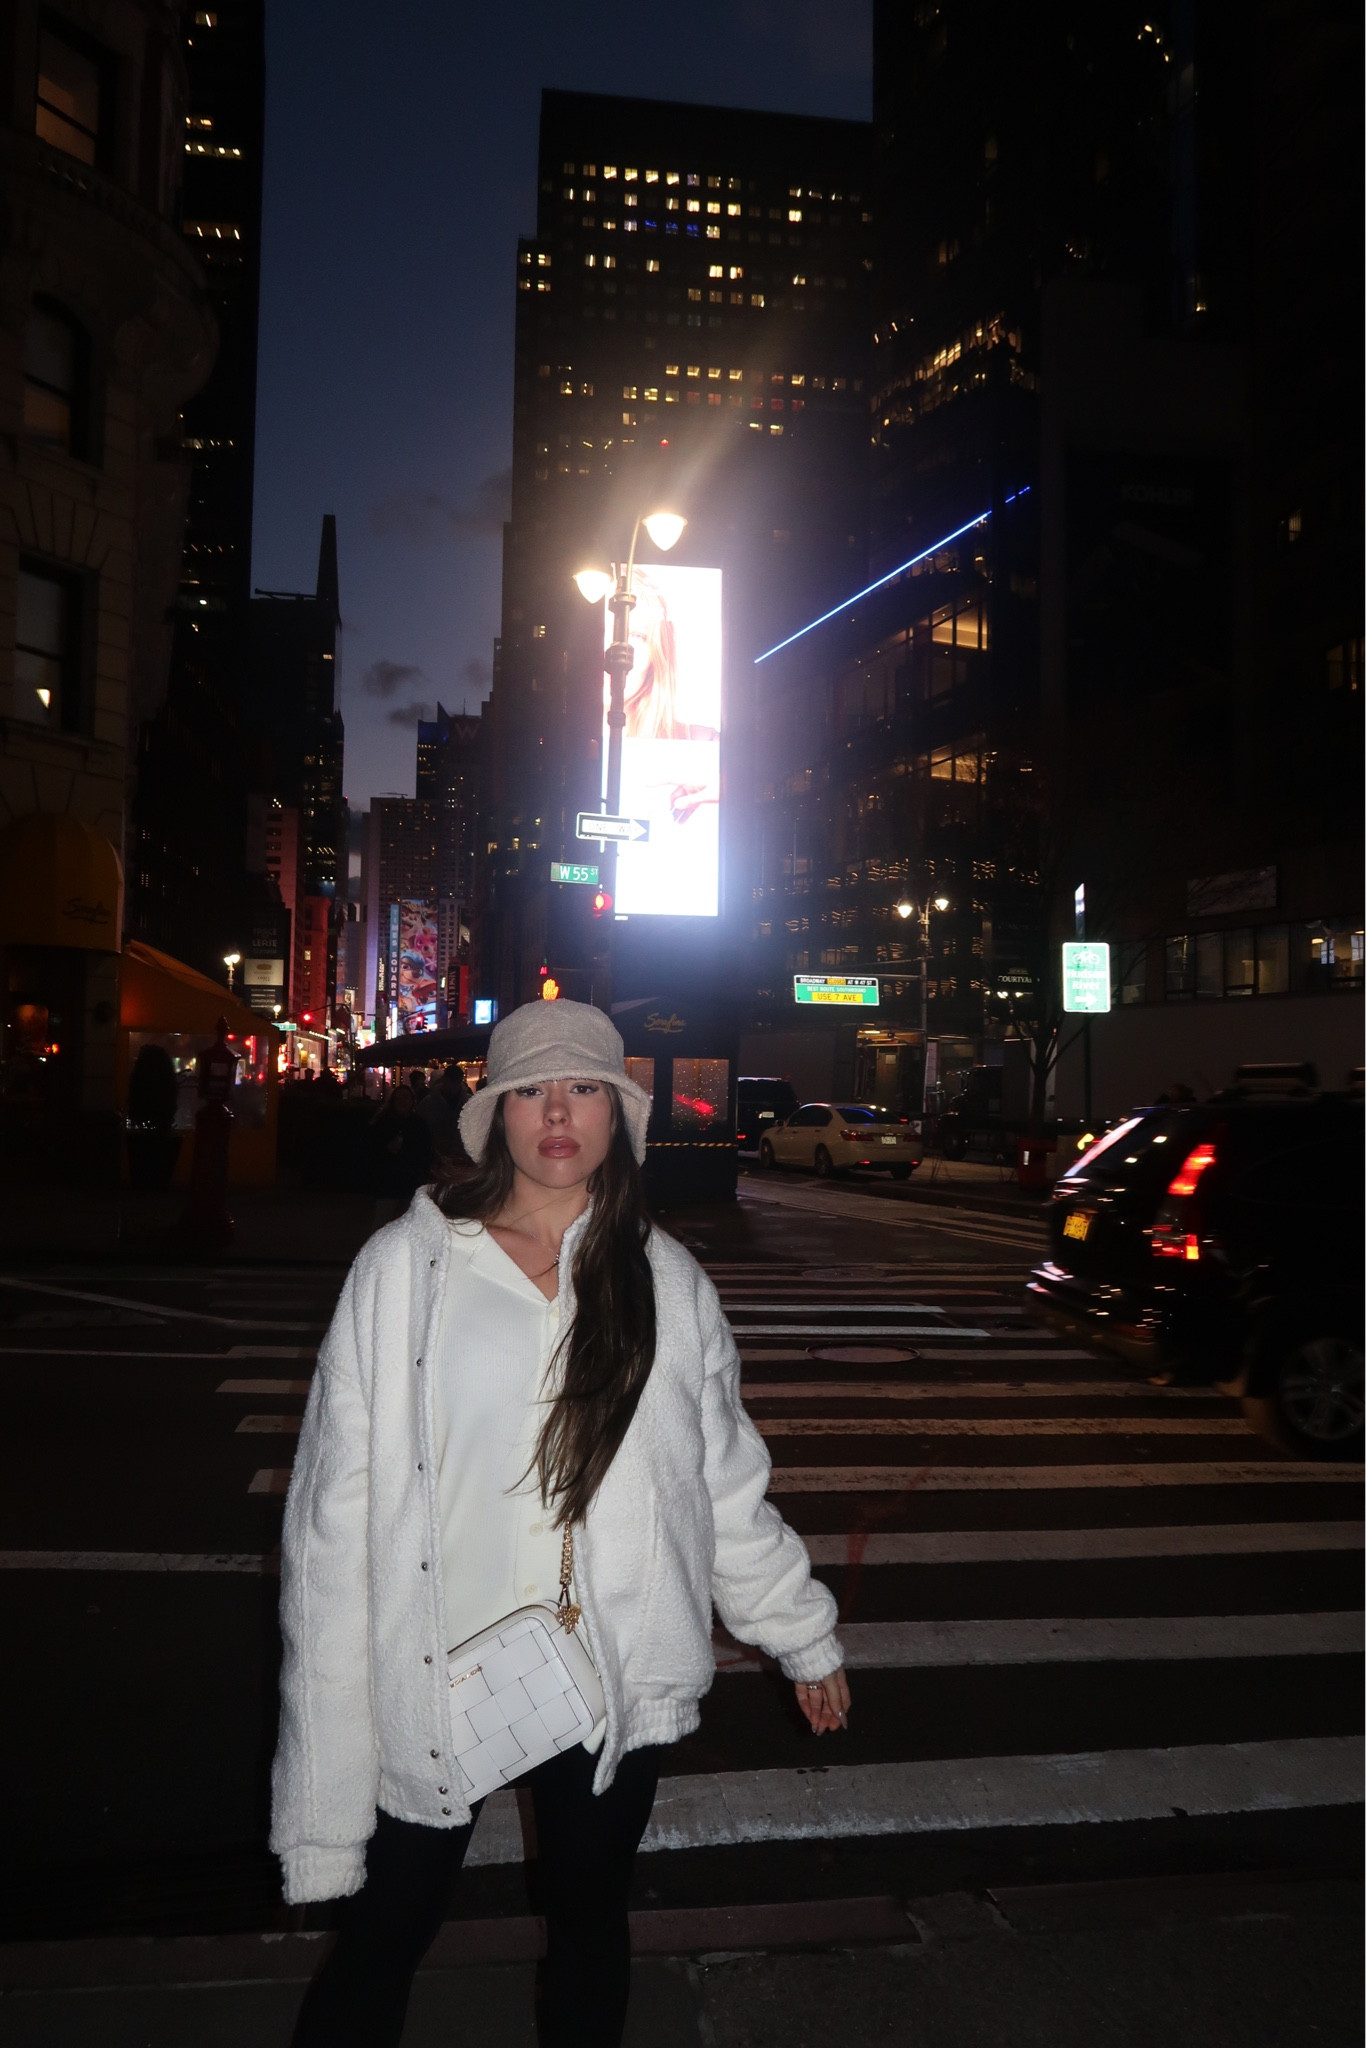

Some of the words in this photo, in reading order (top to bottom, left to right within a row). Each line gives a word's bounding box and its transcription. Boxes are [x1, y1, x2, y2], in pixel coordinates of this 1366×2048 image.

[1120, 484, 1194, 507] KOHLER
[560, 865, 570, 880] W
[573, 867, 589, 881] 55
[591, 868, 598, 876] ST
[391, 909, 399, 947] TIMES
[390, 951, 398, 996] SQUARE
[997, 975, 1040, 983] COURTYA
[1072, 980, 1101, 990] River
[817, 993, 832, 1001] USE
